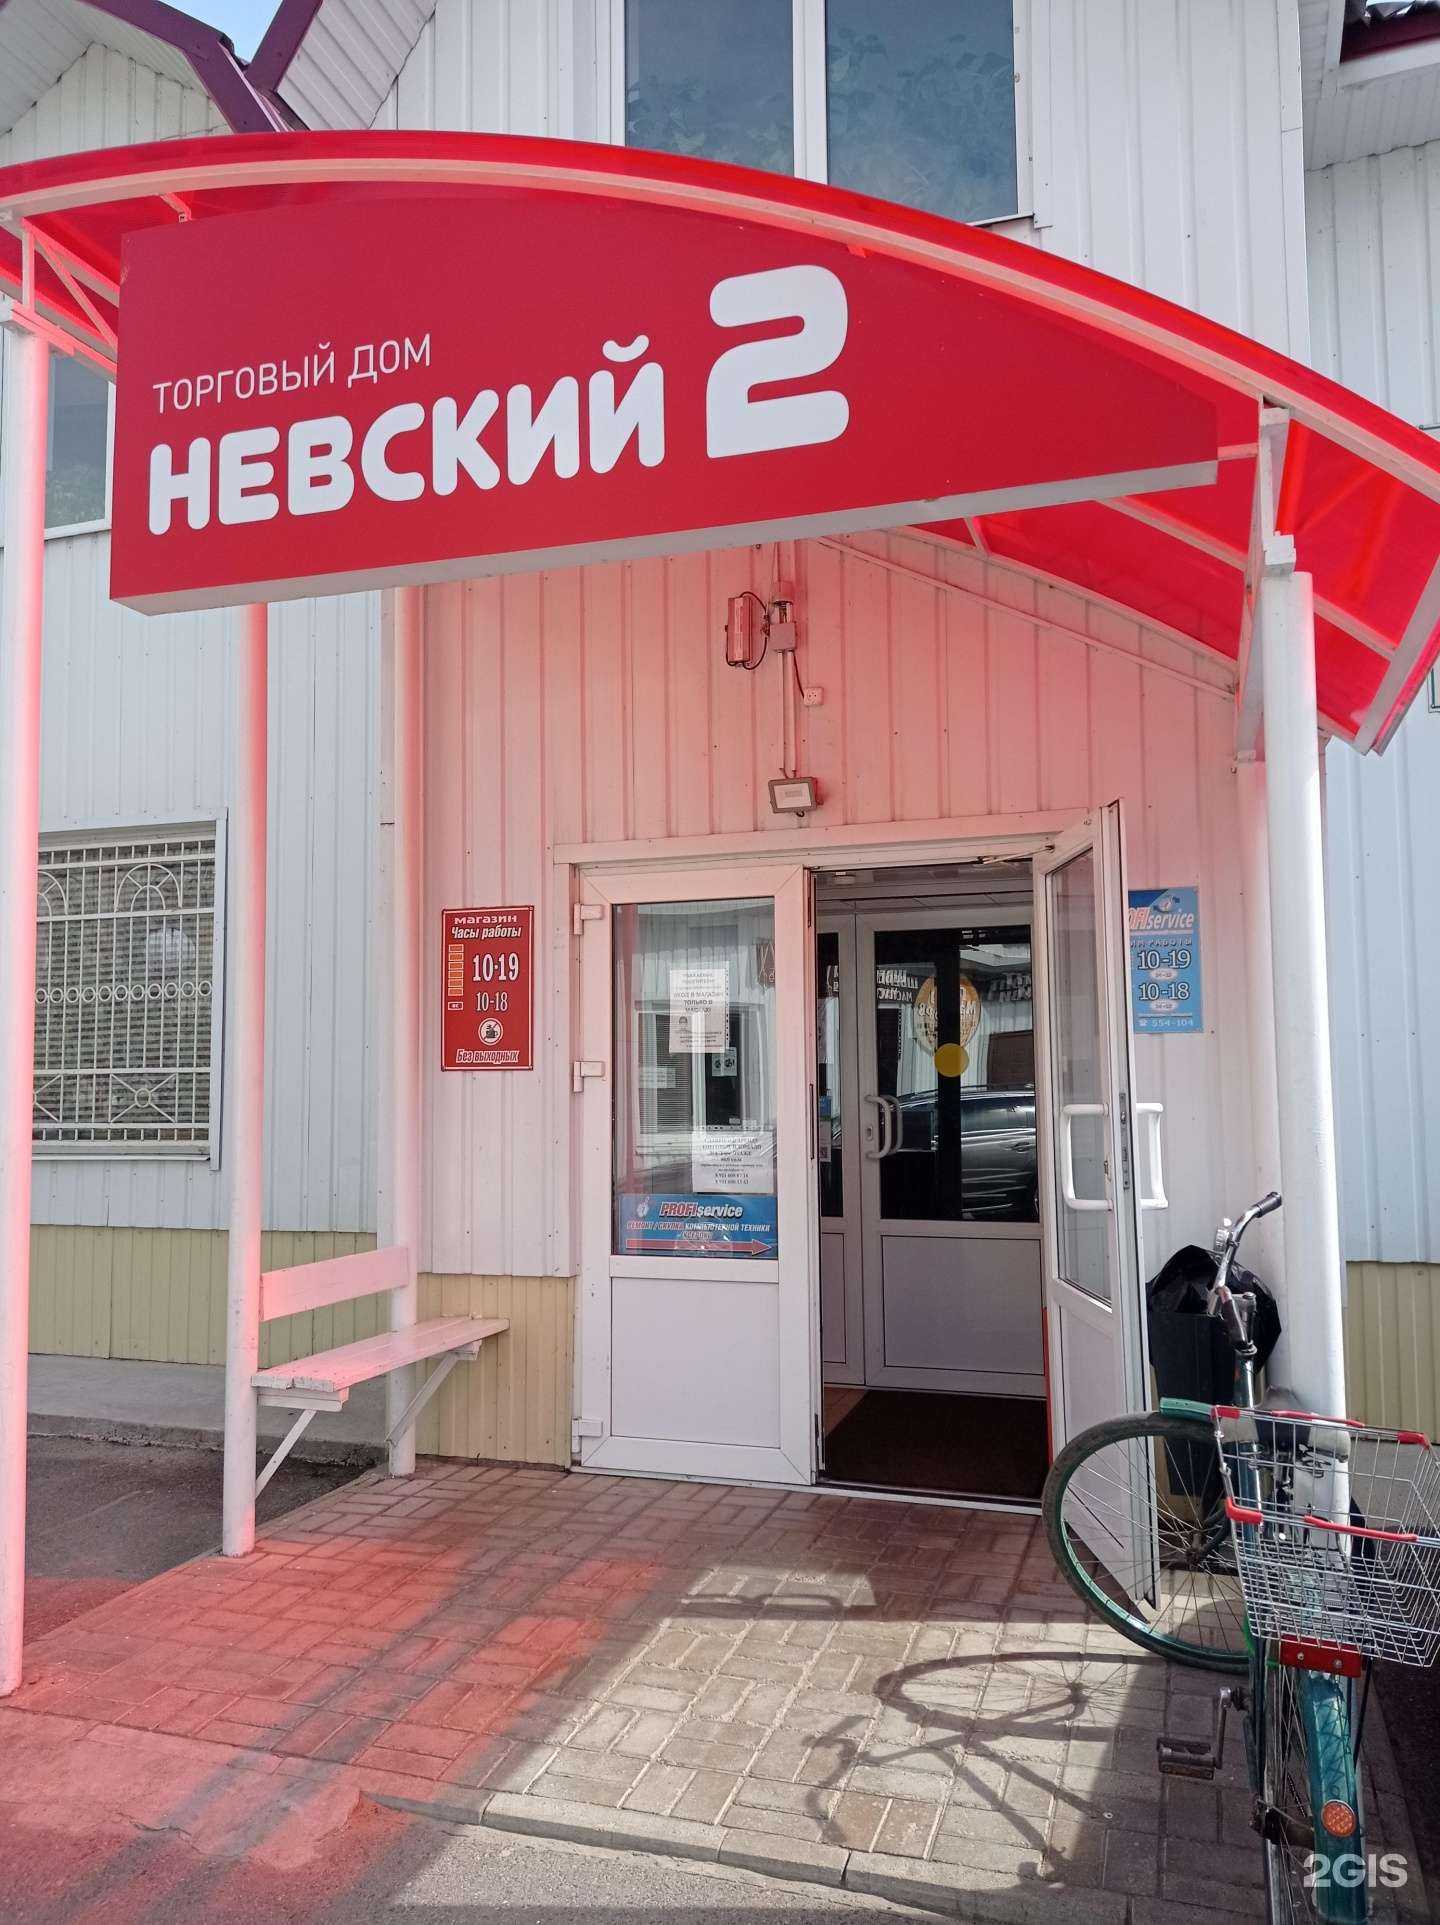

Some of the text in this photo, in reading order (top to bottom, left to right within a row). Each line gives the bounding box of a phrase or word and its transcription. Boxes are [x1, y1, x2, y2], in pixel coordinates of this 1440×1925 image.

[153, 333, 431, 413] ТОРГОВЫЙ ДОМ
[148, 264, 850, 536] НЕВСКИЙ 2
[451, 924, 521, 940] Часы работы
[1138, 949, 1191, 969] 10-19
[1139, 982, 1190, 1001] 10-18
[476, 991, 508, 1012] 10-18
[456, 1049, 519, 1064] Без выходных
[659, 1201, 743, 1218] PROFIservice
